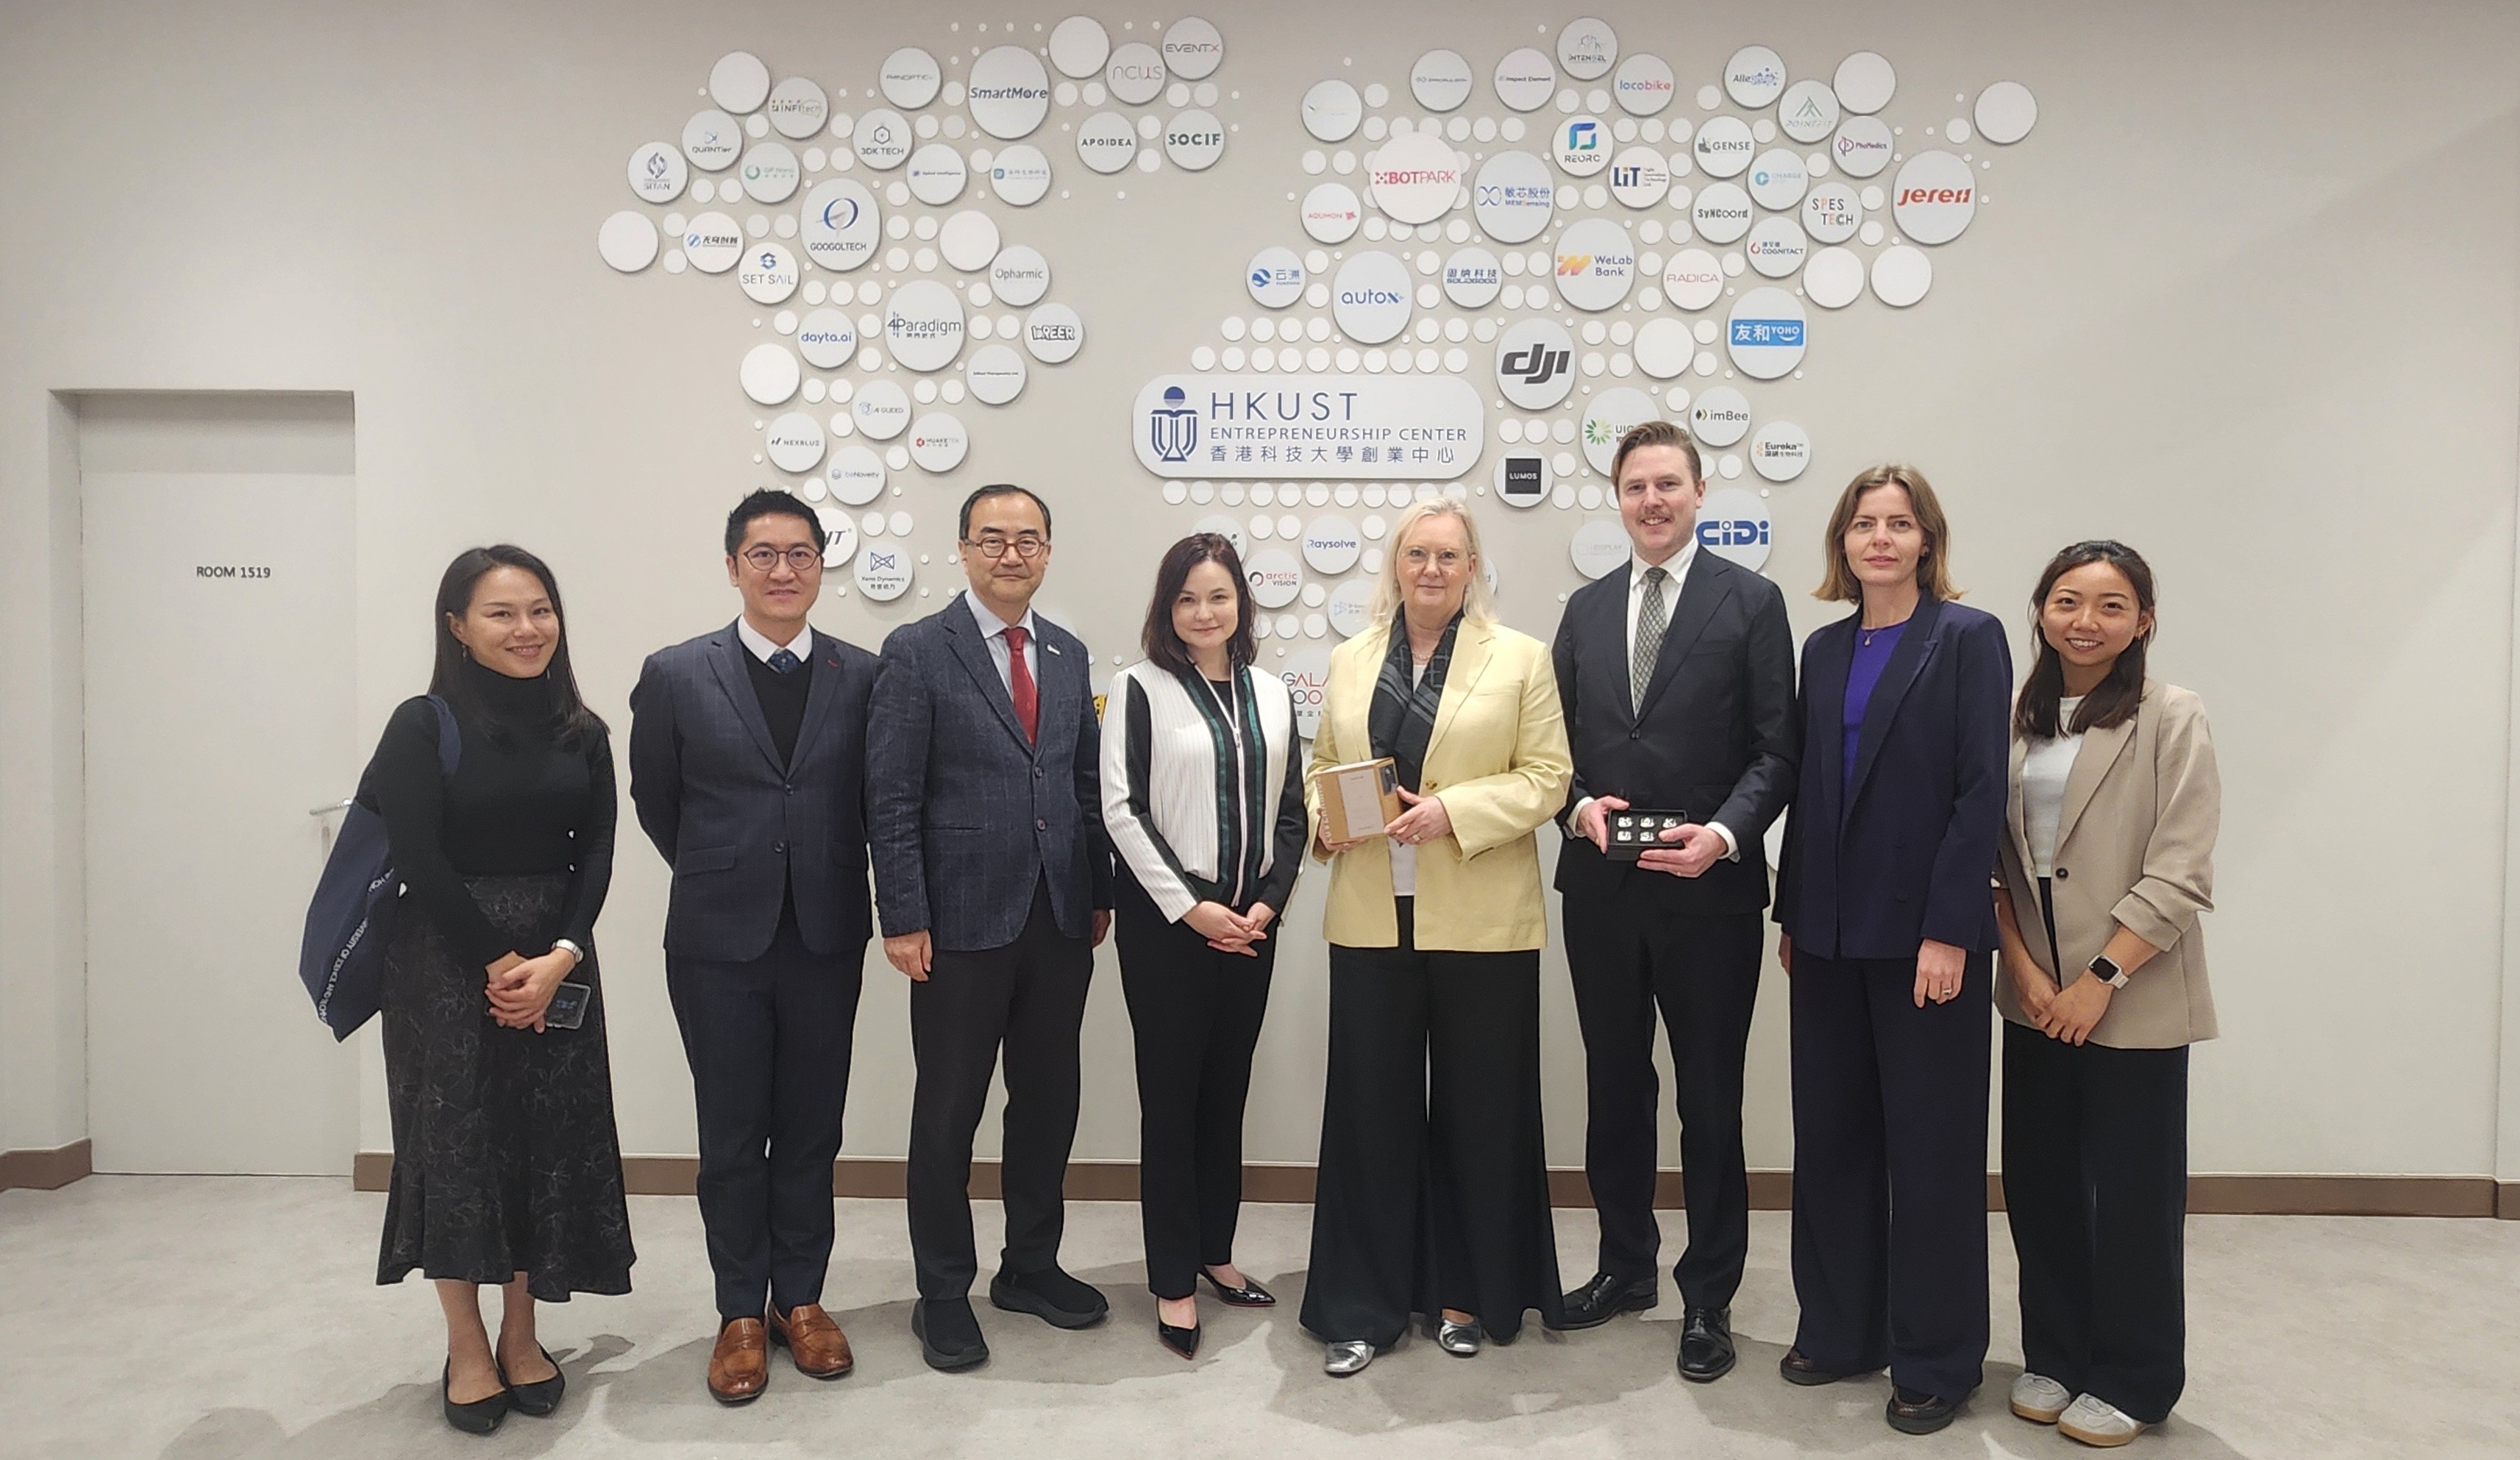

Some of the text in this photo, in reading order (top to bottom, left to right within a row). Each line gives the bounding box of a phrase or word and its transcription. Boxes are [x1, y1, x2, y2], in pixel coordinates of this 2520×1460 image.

[1166, 44, 1219, 52] EVENTX
[1620, 79, 1670, 90] locobike
[971, 87, 1048, 99] SmartMore
[1081, 138, 1132, 147] APOIDEA
[1168, 133, 1220, 146] SOCIF
[883, 147, 904, 155] TECH
[1712, 141, 1751, 151] GENSE
[1565, 154, 1601, 163] REORC
[1812, 198, 1845, 210] SPES
[1820, 213, 1854, 226] TECH
[810, 242, 866, 252] GOOGOLTECH
[1595, 255, 1633, 266] WeLab
[995, 268, 1043, 281] Opharmic
[1595, 267, 1625, 277] Bank
[742, 274, 794, 285] SET SAIL
[1666, 274, 1720, 282] RADICA
[800, 332, 852, 344] dayta.ai
[1734, 324, 1801, 342] 友和 YOHO
[1211, 392, 1358, 421] HKUST
[1710, 410, 1748, 421] imBee
[1211, 427, 1467, 441] ENTREPRENEURSHIP CENTER
[1210, 445, 1455, 464] 香港科技大學創業中心
[1509, 472, 1538, 480] LUMOS
[1307, 539, 1356, 549] Raysolve
[196, 566, 271, 579] ROOM 1519
[1266, 572, 1298, 580] arctic
